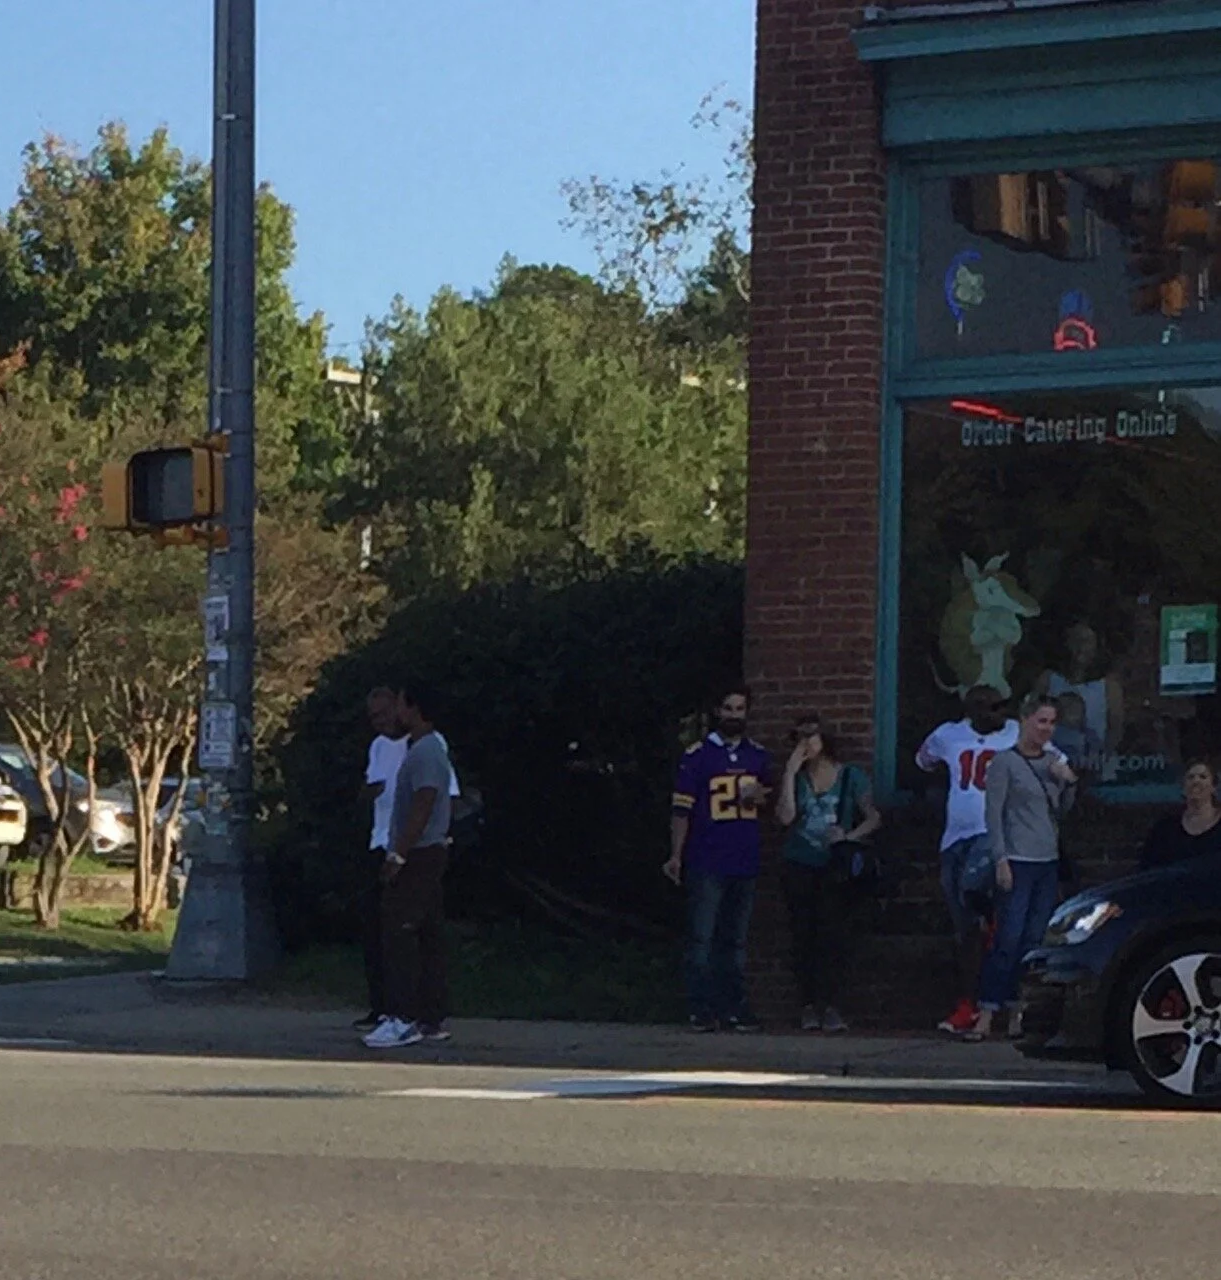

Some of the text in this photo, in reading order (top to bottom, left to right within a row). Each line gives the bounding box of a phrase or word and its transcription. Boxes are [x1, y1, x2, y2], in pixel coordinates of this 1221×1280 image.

[961, 408, 1178, 447] Order Catering Online
